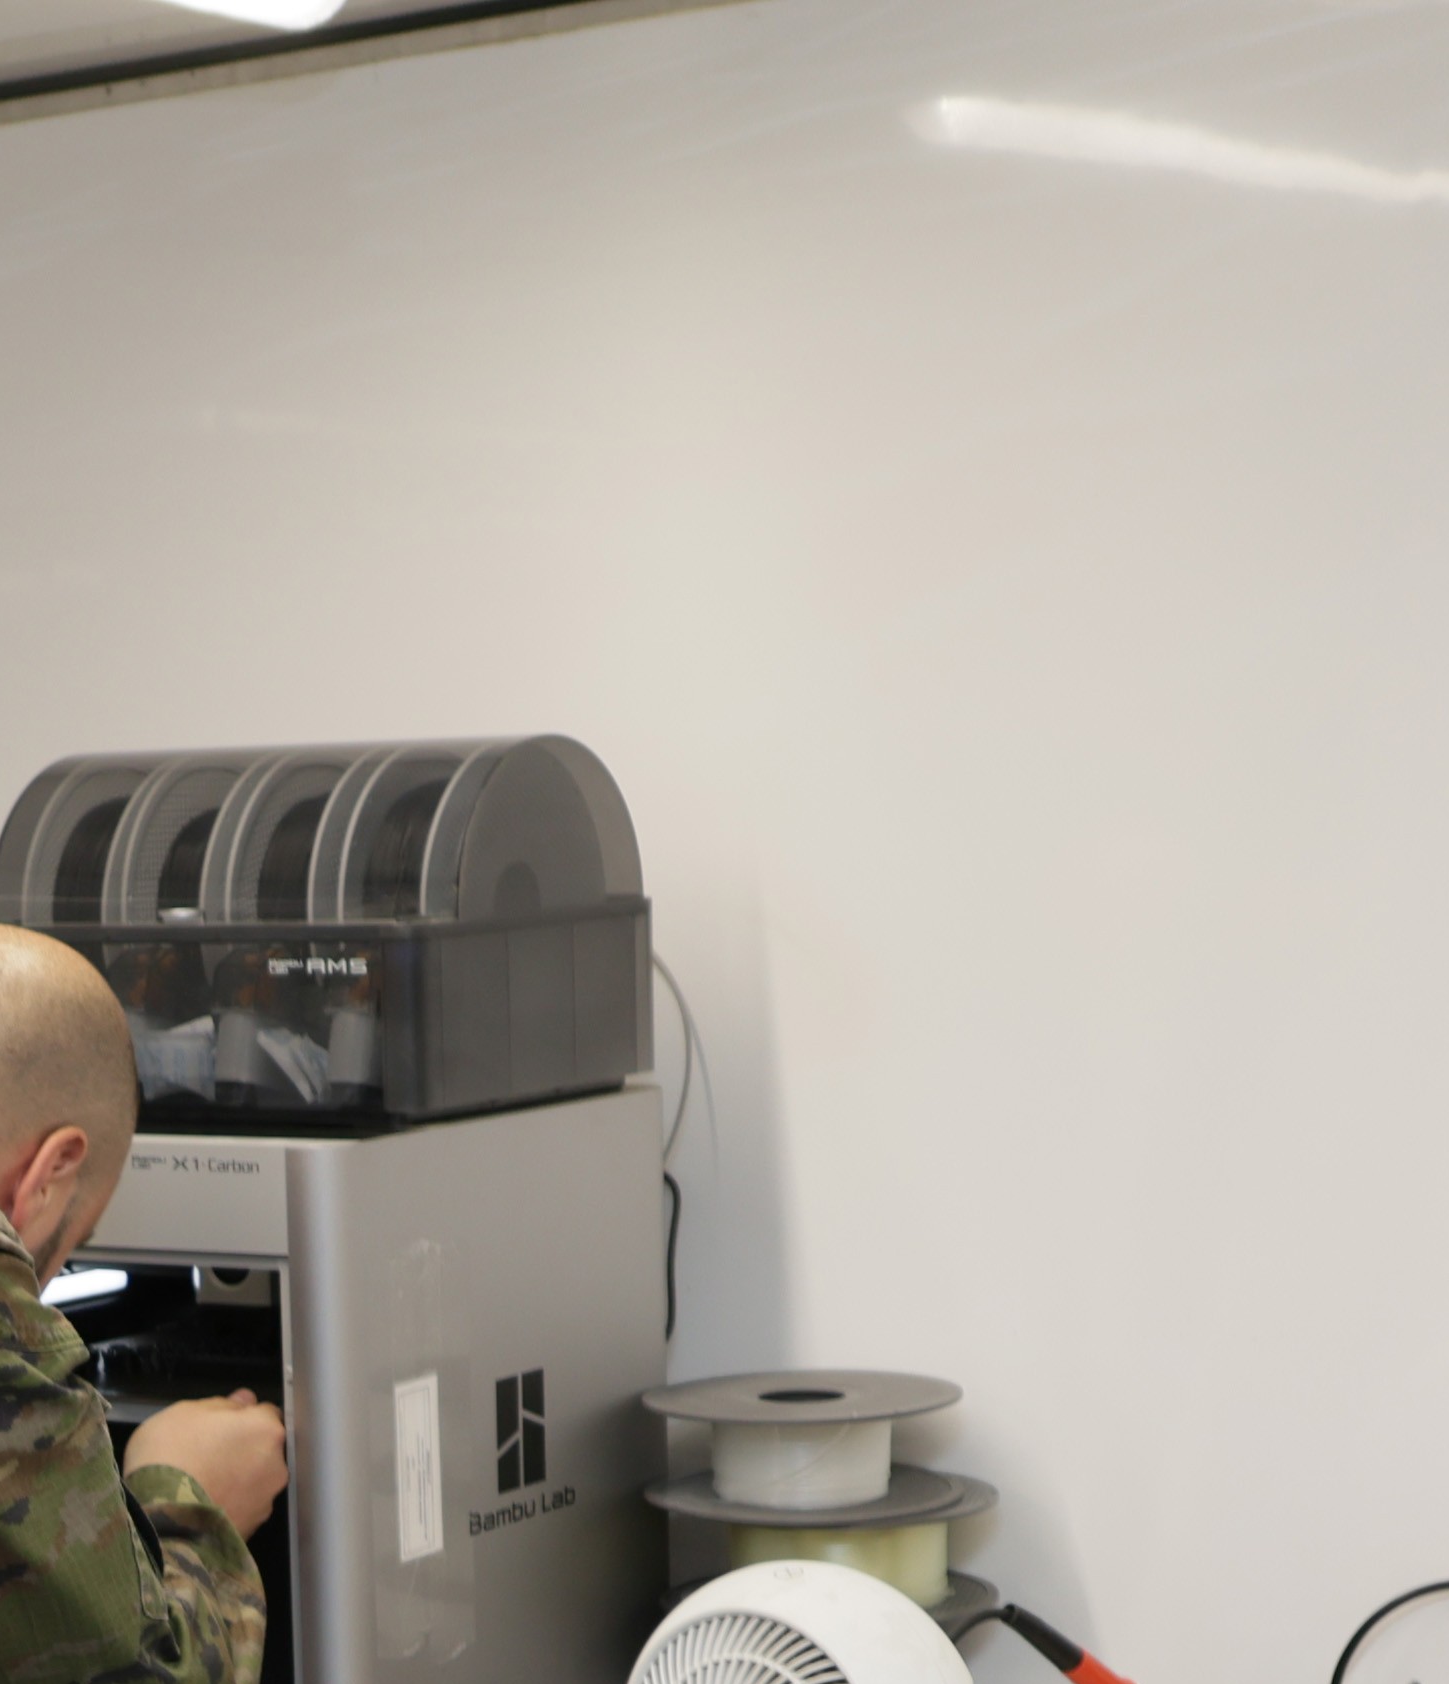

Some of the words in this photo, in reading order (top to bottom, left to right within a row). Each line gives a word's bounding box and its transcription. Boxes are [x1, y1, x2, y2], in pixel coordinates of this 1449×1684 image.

[306, 957, 368, 975] AMS
[469, 1499, 536, 1537] Bambu
[541, 1485, 576, 1514] Lab
